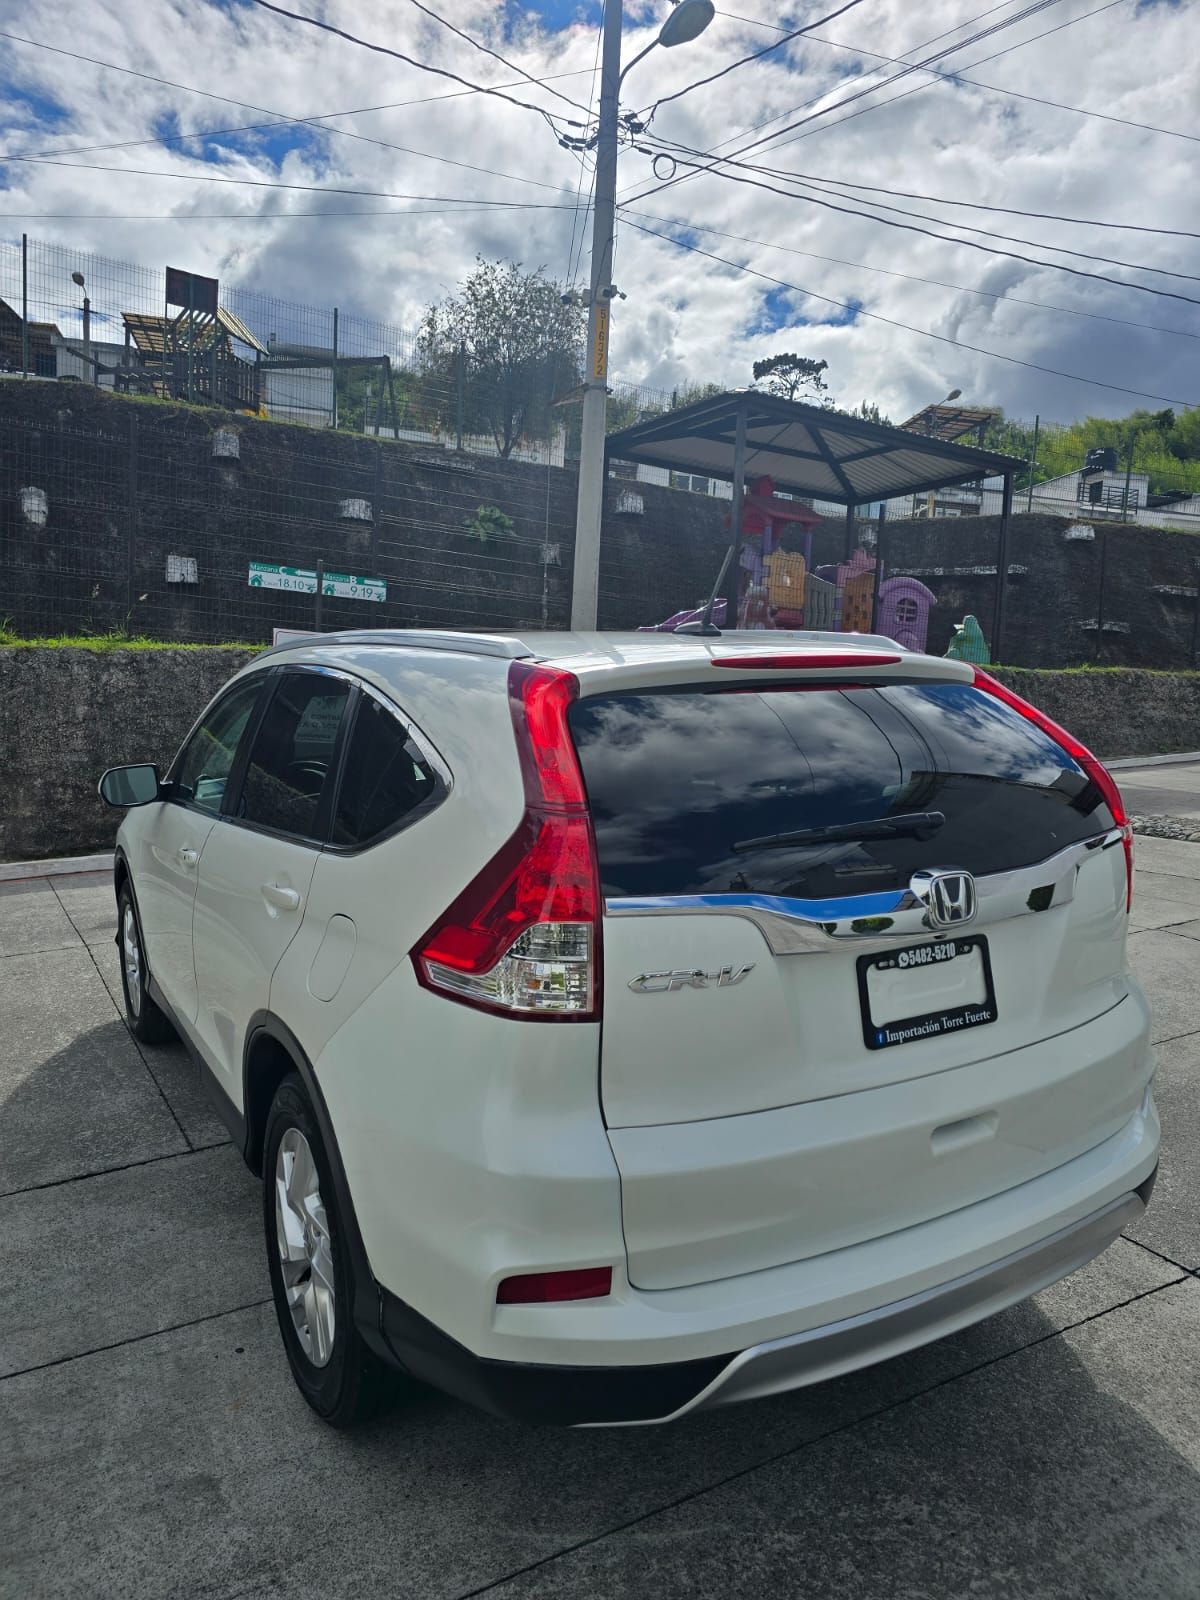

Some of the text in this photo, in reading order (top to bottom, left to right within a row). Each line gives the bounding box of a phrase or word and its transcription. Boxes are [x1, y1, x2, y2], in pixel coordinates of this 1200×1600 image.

[249, 563, 288, 575] Manzana C
[322, 572, 358, 585] Manzana B
[908, 942, 956, 966] 5482-5210
[627, 962, 756, 994] CR-V
[885, 1020, 941, 1044] Importación
[940, 1015, 964, 1030] Torre
[964, 1010, 992, 1024] Fuerte
